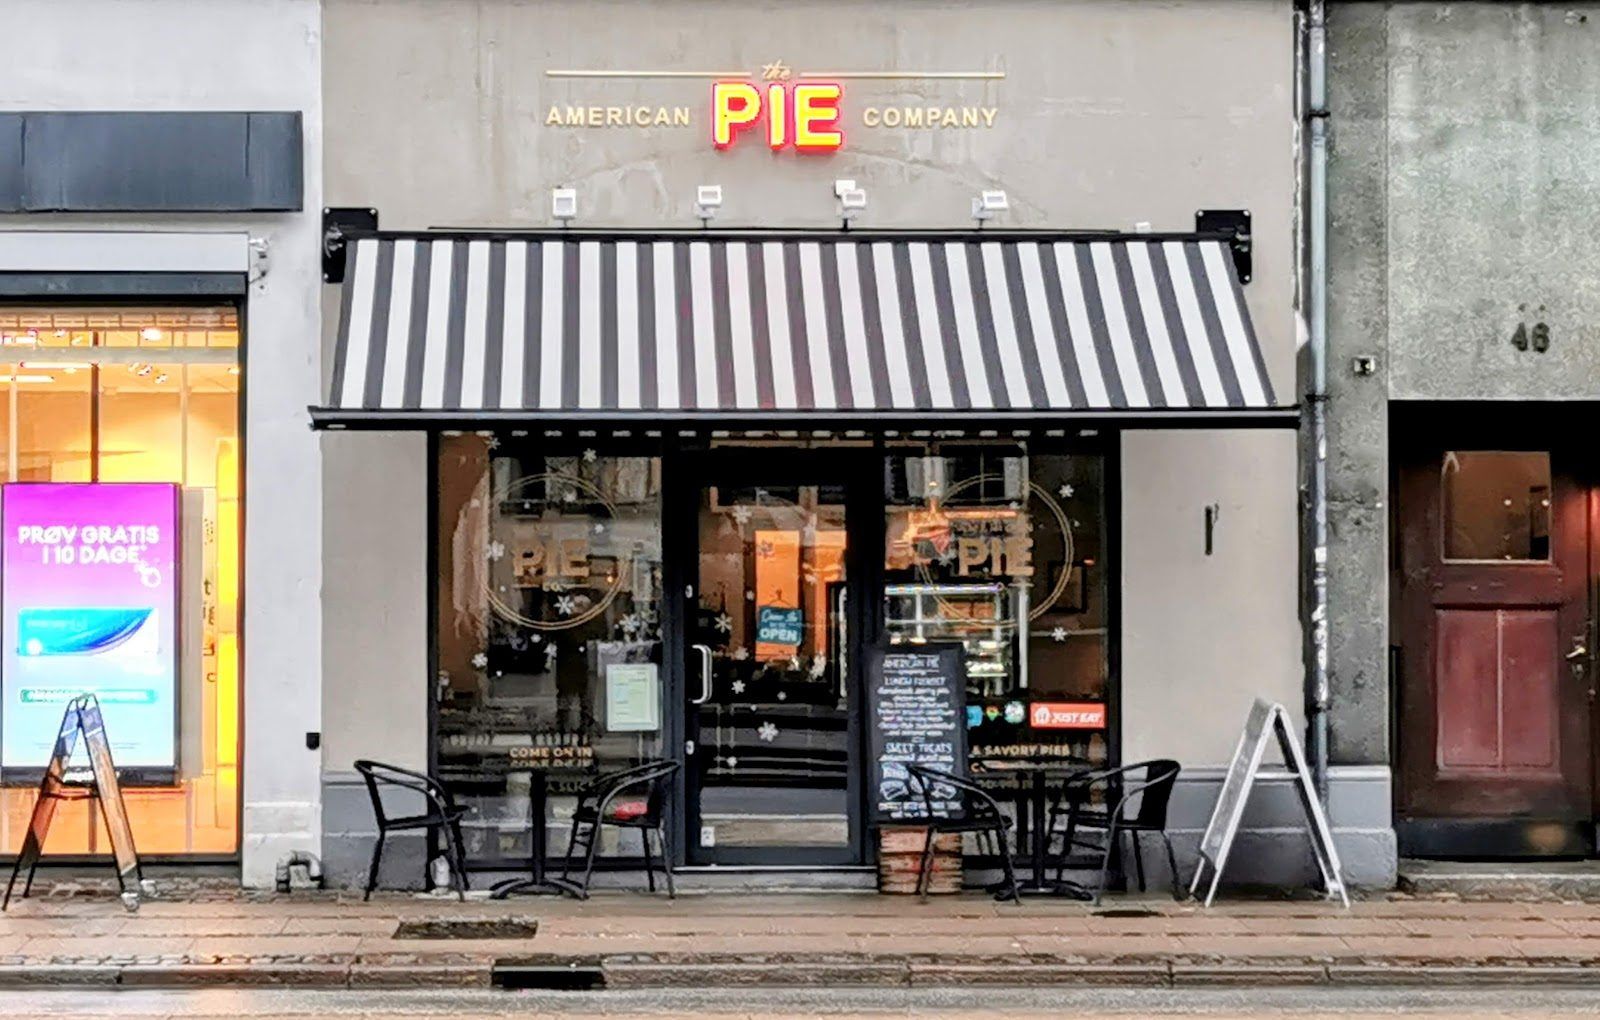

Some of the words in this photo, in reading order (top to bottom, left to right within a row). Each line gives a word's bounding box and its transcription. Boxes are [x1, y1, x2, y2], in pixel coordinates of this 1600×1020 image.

[762, 63, 793, 81] the
[545, 105, 691, 127] AMERICAN
[711, 82, 844, 149] PIE
[862, 106, 999, 127] COMPANY
[1511, 322, 1551, 353] 46
[17, 525, 78, 546] PRØV
[81, 525, 161, 545] GRATIS
[54, 546, 75, 564] 10
[513, 540, 590, 577] PIE
[959, 537, 1034, 577] PIE
[760, 628, 798, 641] OPEN
[1051, 711, 1077, 724] JUST
[1079, 711, 1101, 723] EAT
[509, 746, 549, 759] COME
[552, 746, 574, 759] ON
[577, 746, 593, 758] IN
[983, 744, 1038, 757] SAVORY
[1039, 743, 1071, 757] PIES
